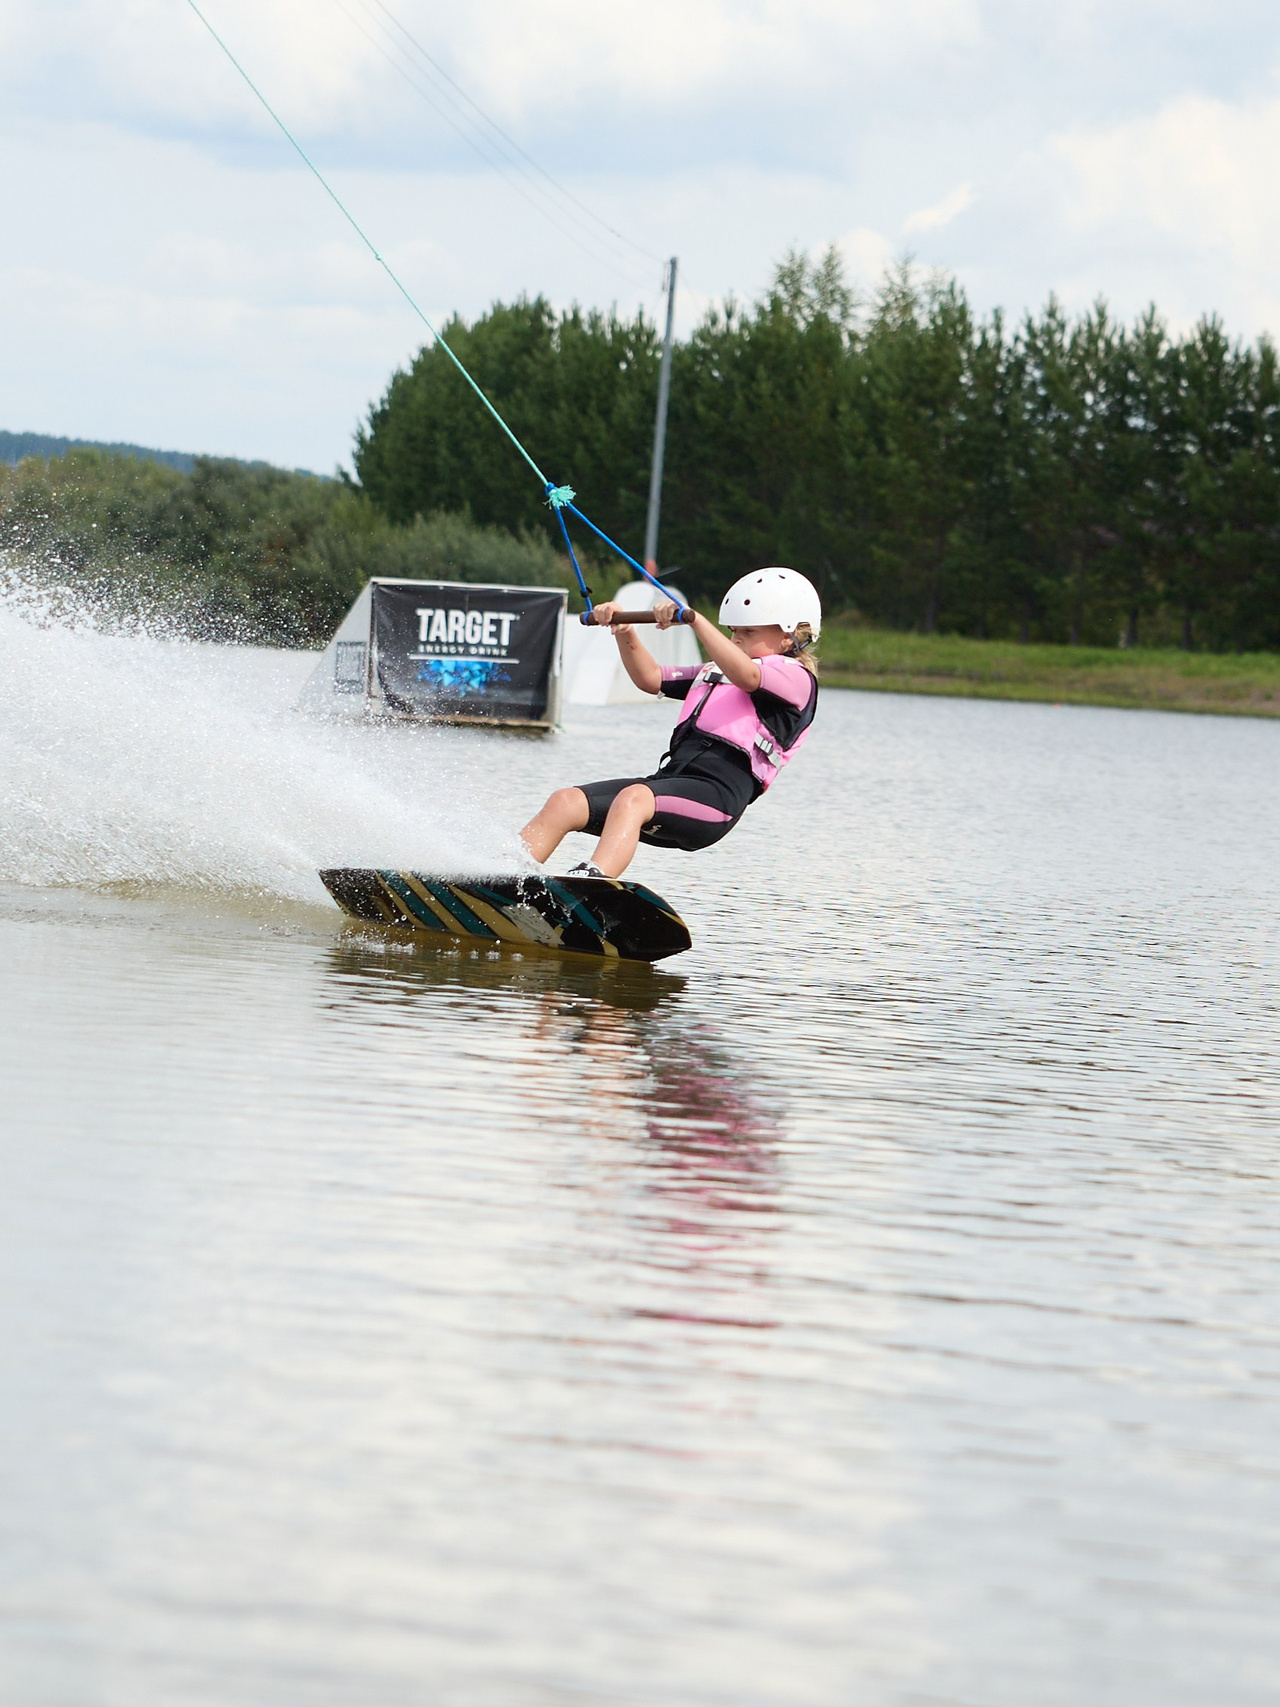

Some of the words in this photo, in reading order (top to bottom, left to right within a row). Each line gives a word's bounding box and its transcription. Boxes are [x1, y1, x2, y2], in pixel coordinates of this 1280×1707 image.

[415, 608, 517, 646] TARGET
[418, 644, 464, 654] ENERGY
[469, 646, 507, 656] DRINK
